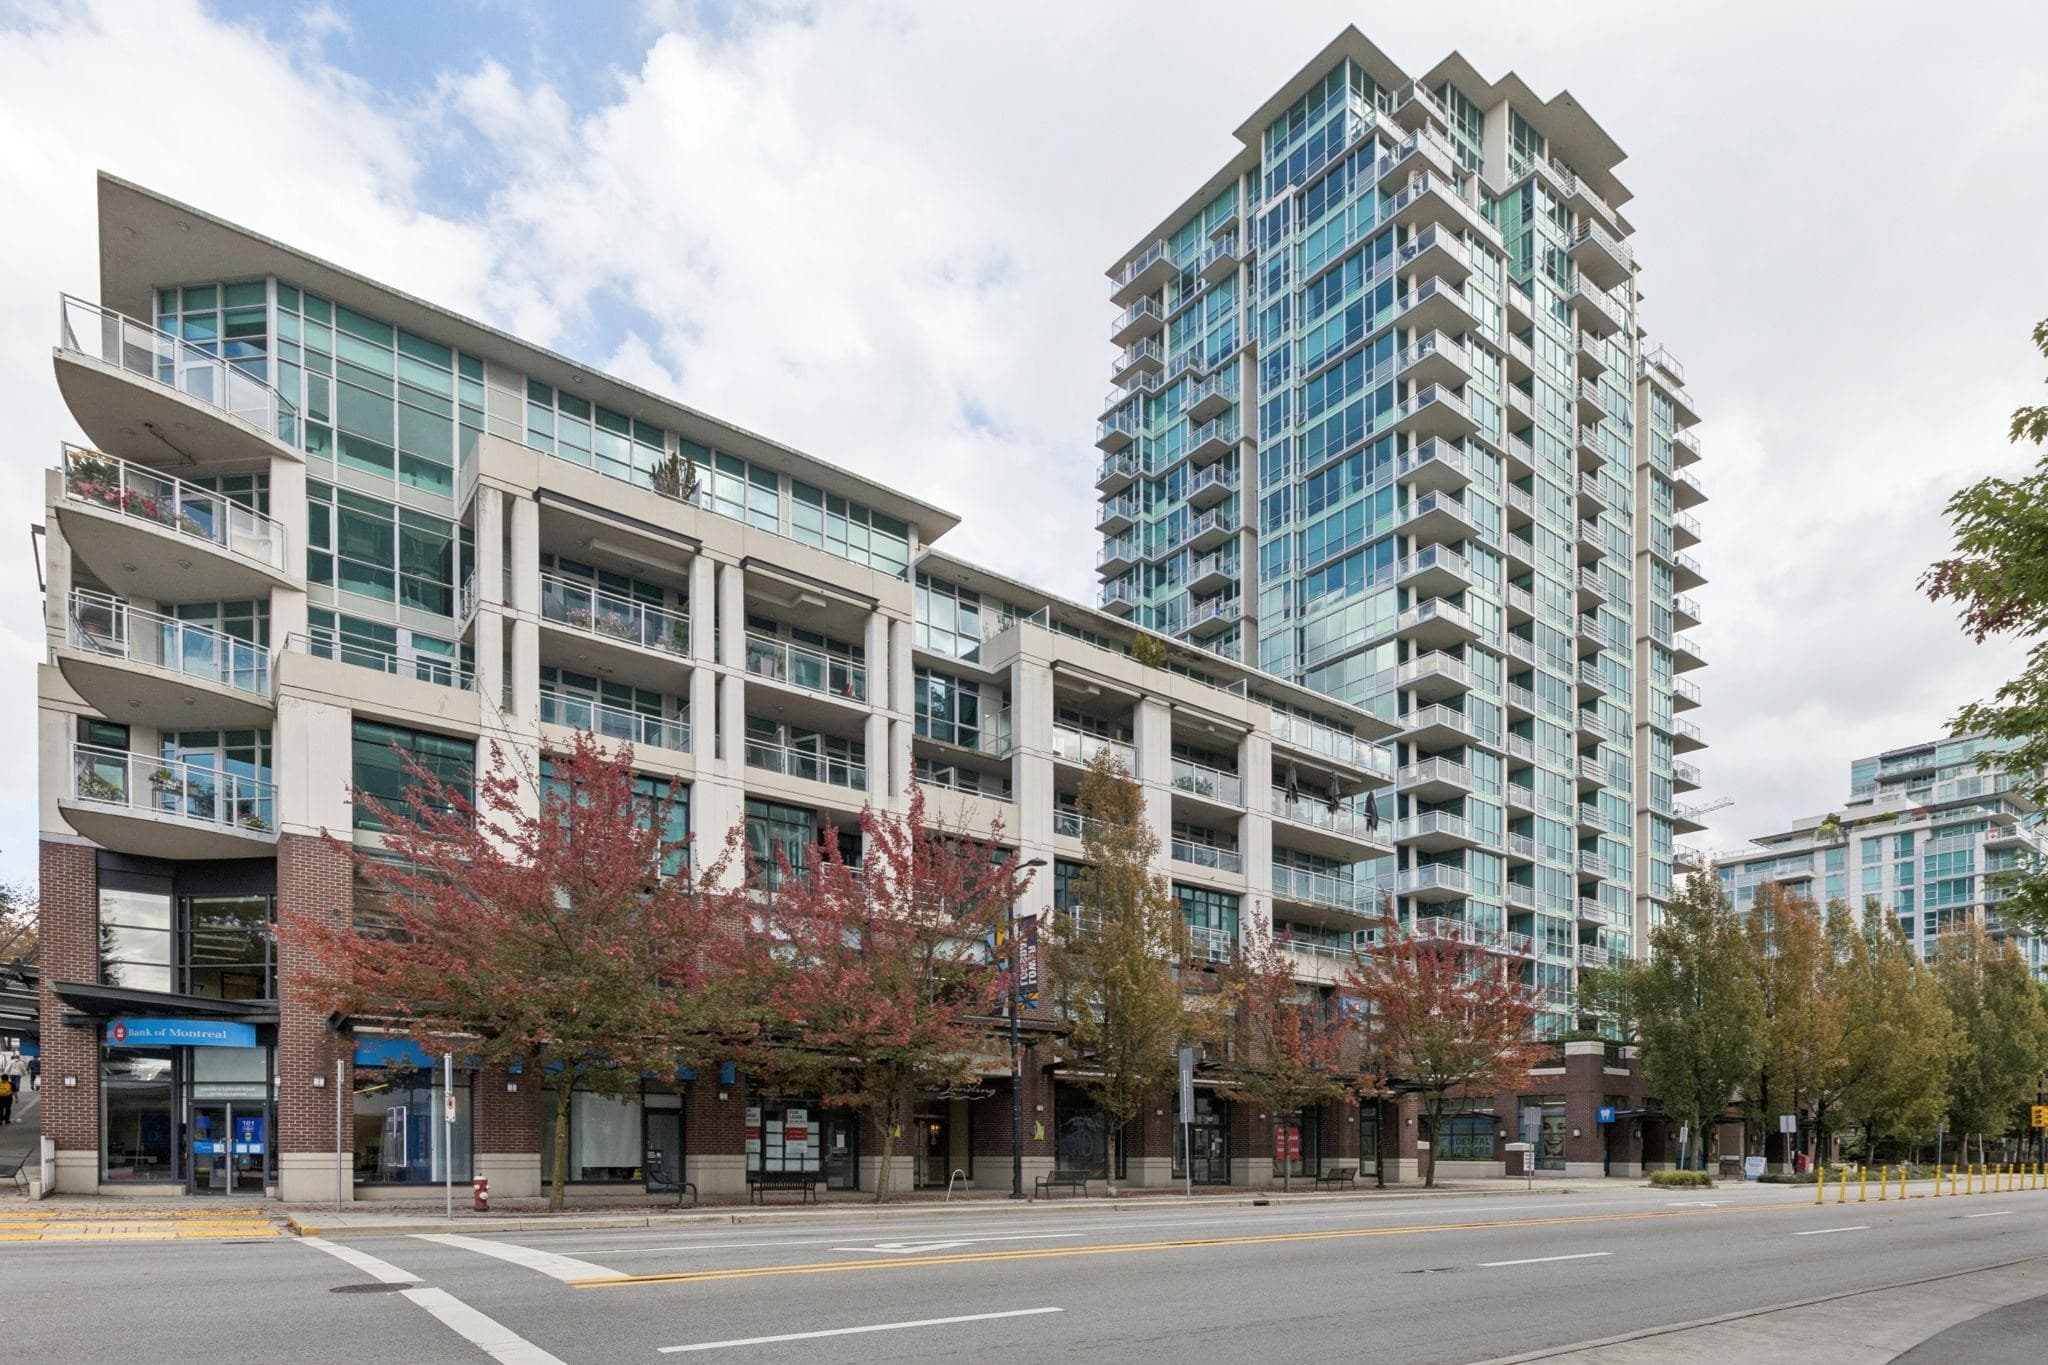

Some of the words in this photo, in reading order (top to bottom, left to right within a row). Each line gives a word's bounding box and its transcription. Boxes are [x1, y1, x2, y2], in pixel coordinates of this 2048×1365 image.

[128, 1028, 152, 1037] Bank
[154, 1028, 166, 1037] of
[169, 1028, 228, 1039] Montreal
[940, 1085, 996, 1098] Landing
[1455, 1137, 1490, 1145] DENTAL
